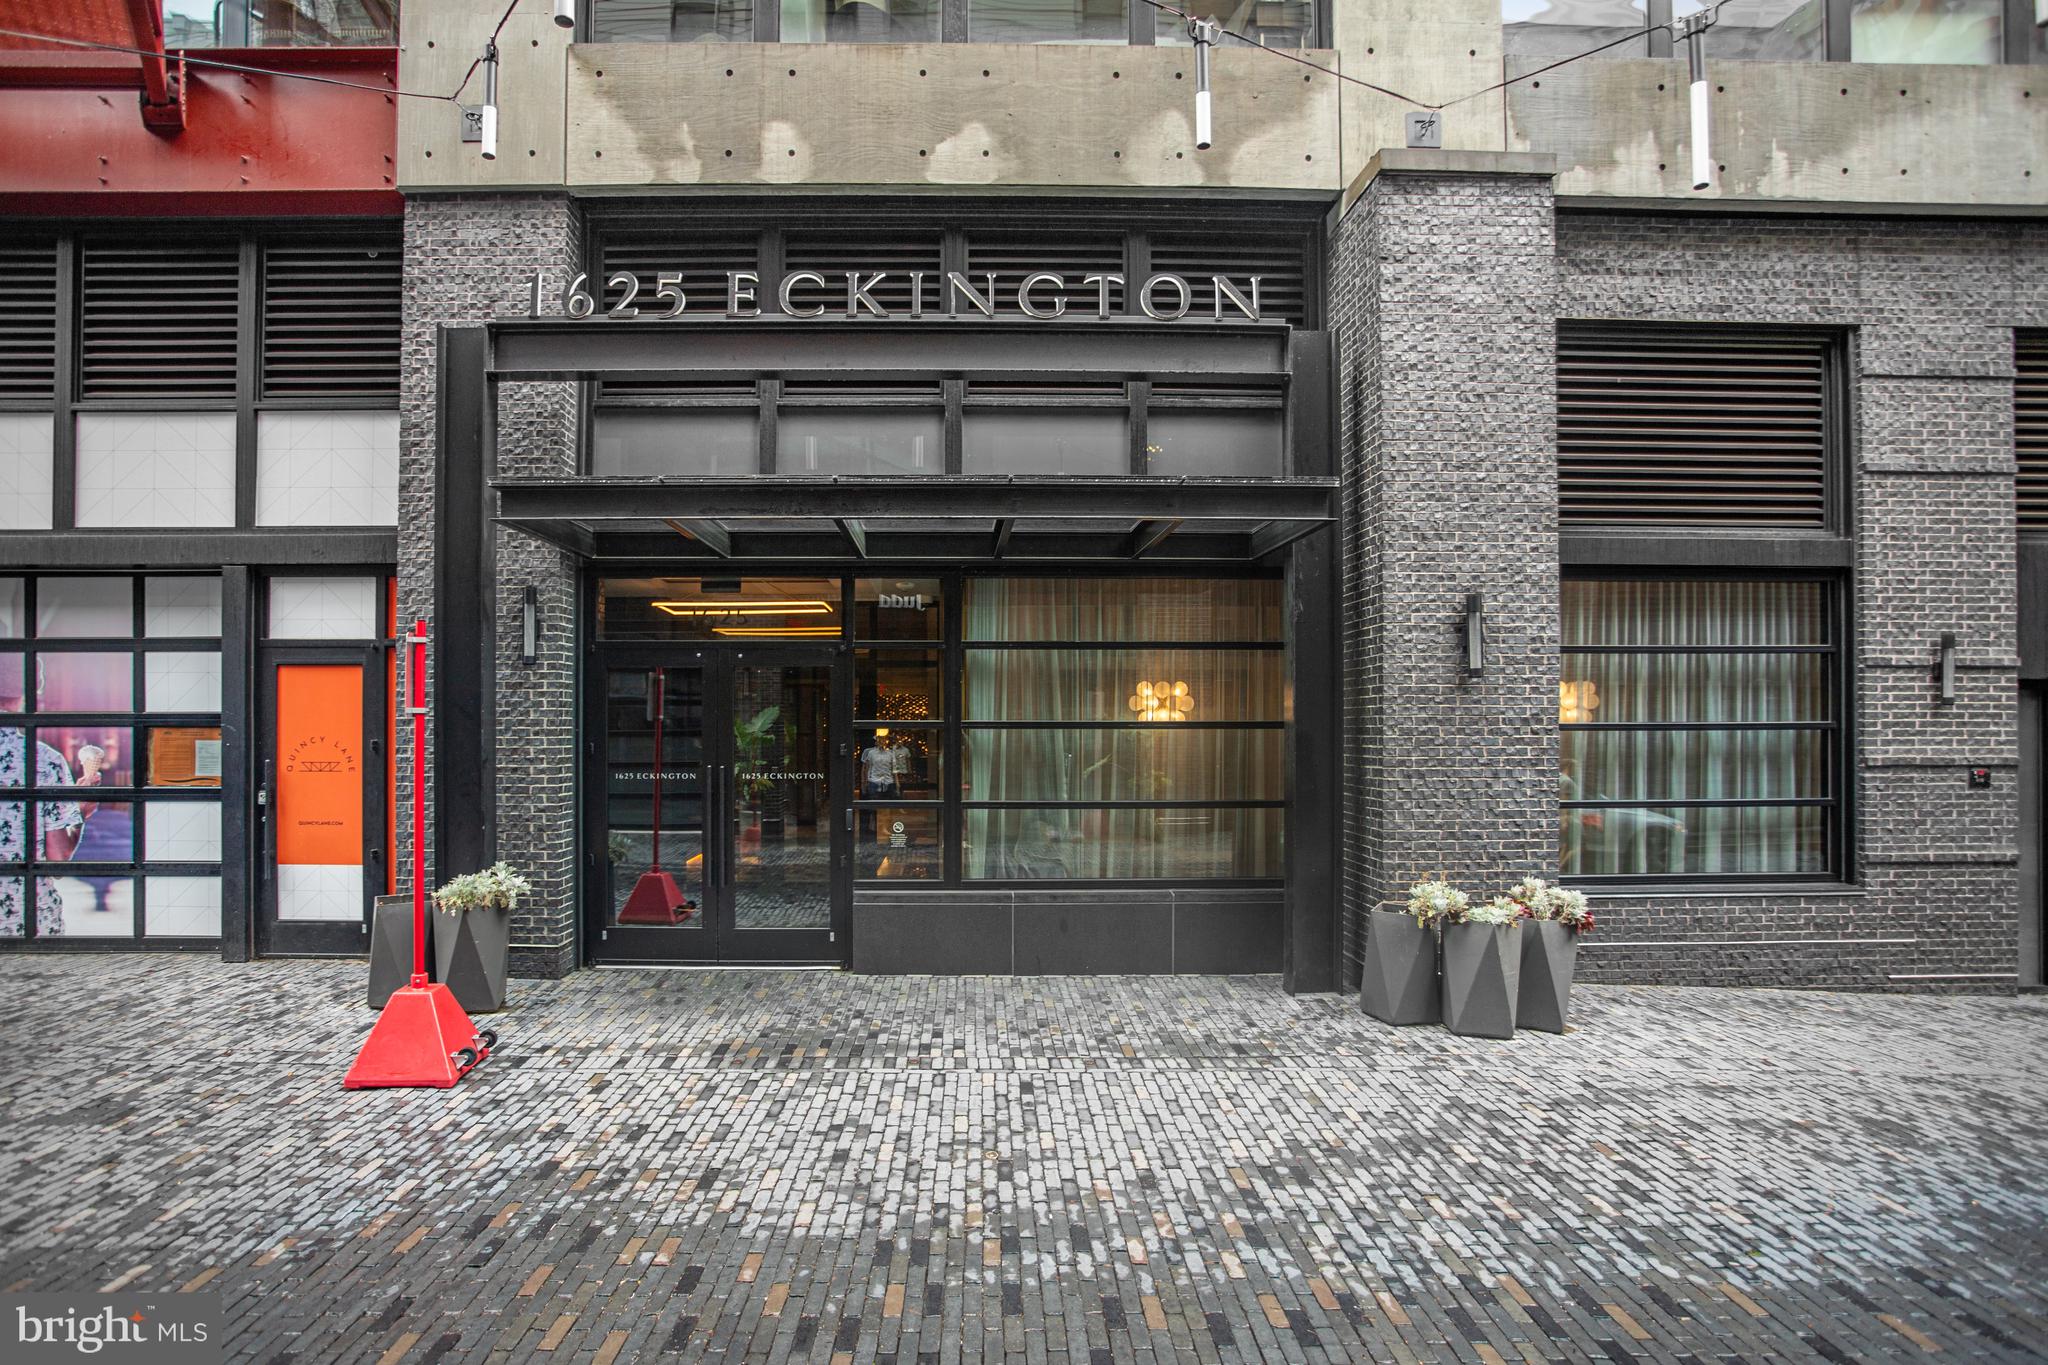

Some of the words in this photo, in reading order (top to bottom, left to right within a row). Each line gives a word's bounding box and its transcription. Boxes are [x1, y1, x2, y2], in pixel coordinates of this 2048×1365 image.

[525, 271, 686, 319] 1625
[725, 270, 1261, 322] ECKINGTON
[286, 736, 325, 773] QUINCY
[333, 741, 356, 773] LANE
[615, 772, 634, 780] 1625
[636, 772, 697, 780] ECKINGTON
[742, 772, 762, 780] 1625
[764, 772, 825, 780] ECKINGTON
